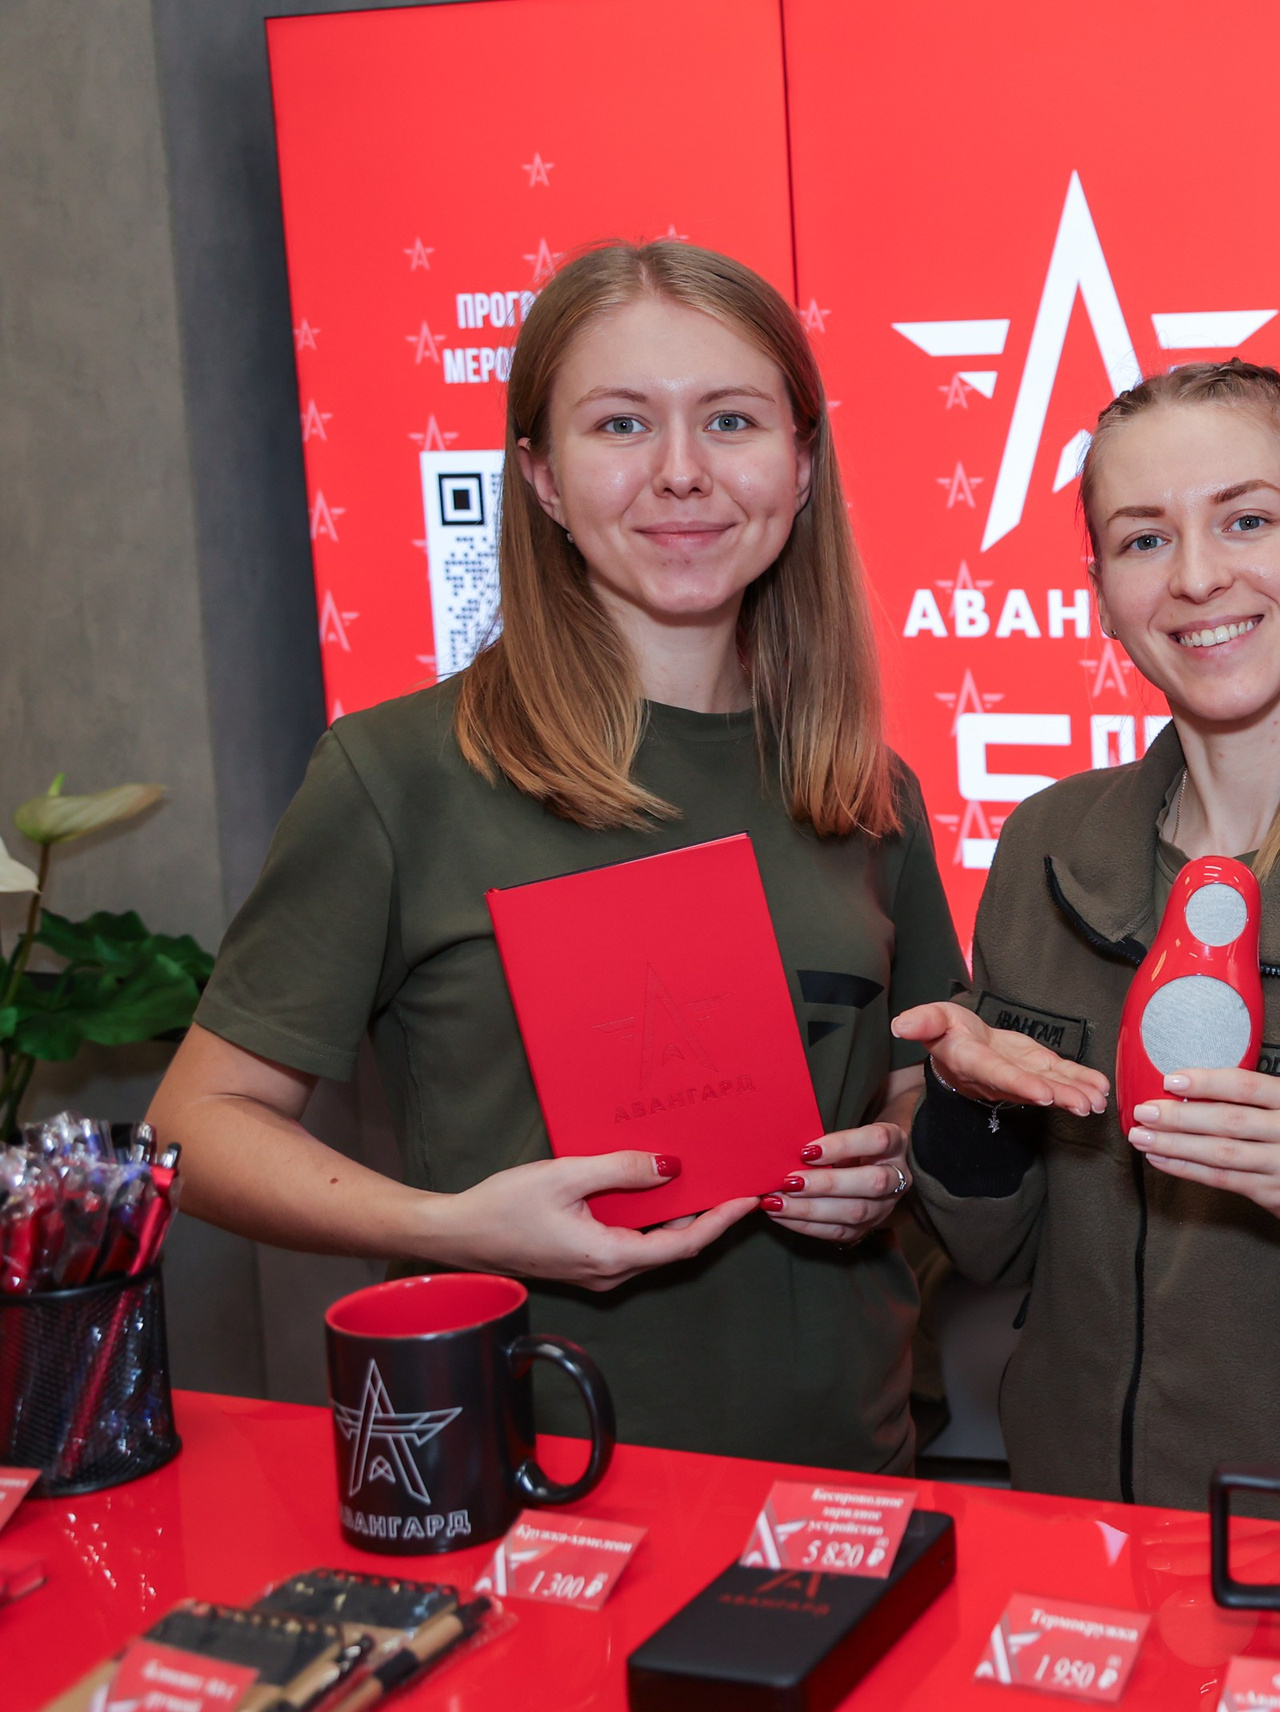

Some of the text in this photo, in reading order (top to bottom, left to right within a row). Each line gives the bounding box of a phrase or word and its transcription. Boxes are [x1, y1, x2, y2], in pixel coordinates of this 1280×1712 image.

[456, 290, 543, 329] ПРОГР
[443, 346, 516, 384] МЕРО
[903, 589, 1113, 638] АВАН
[614, 1073, 757, 1125] АВАНГАРД
[341, 1504, 472, 1540] ВАНГАРД
